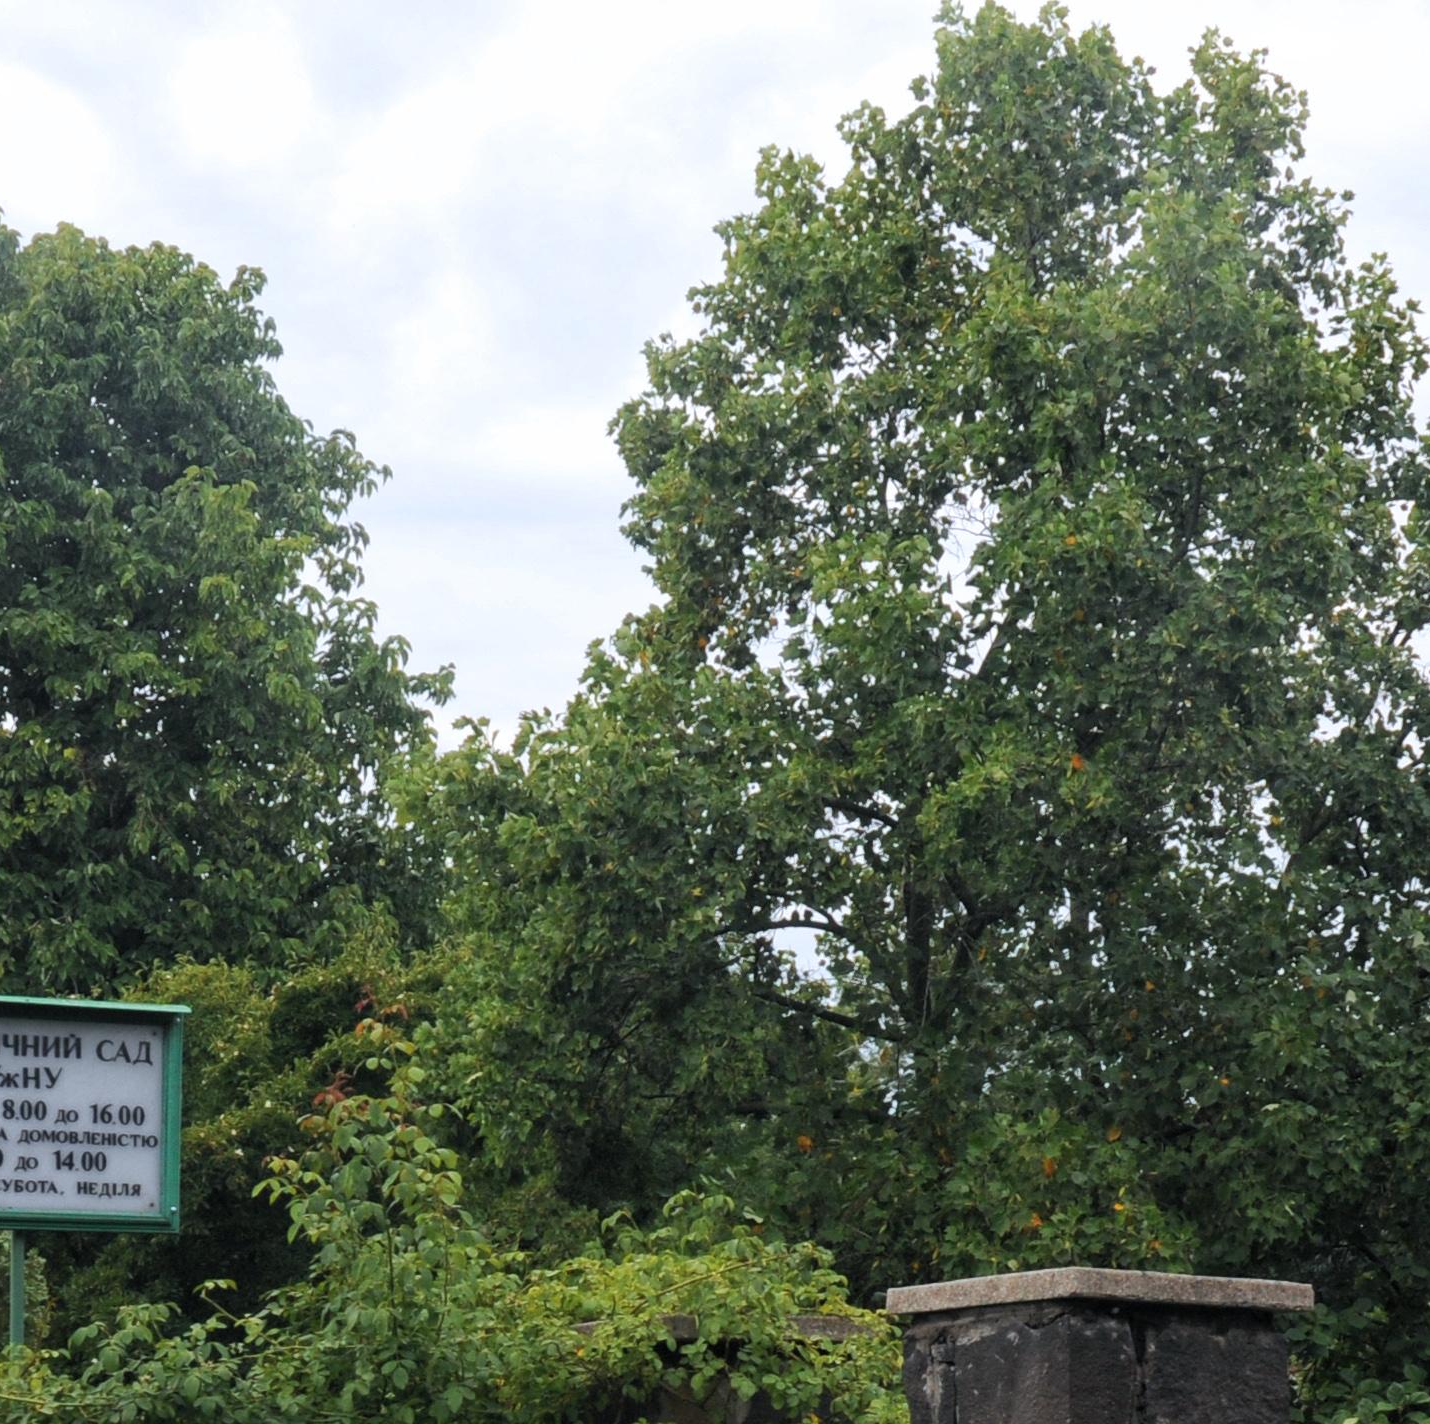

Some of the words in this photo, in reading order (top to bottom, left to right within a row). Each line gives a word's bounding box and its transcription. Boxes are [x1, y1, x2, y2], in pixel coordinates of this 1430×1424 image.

[96, 1040, 153, 1065] САД
[2, 1099, 47, 1121] 8.00
[89, 1103, 146, 1126] 16.00
[17, 1129, 159, 1148] ДОМОВЛЕНІСТЮ
[53, 1150, 107, 1172] 14.00
[77, 1181, 142, 1198] НЕДІЛЯ
